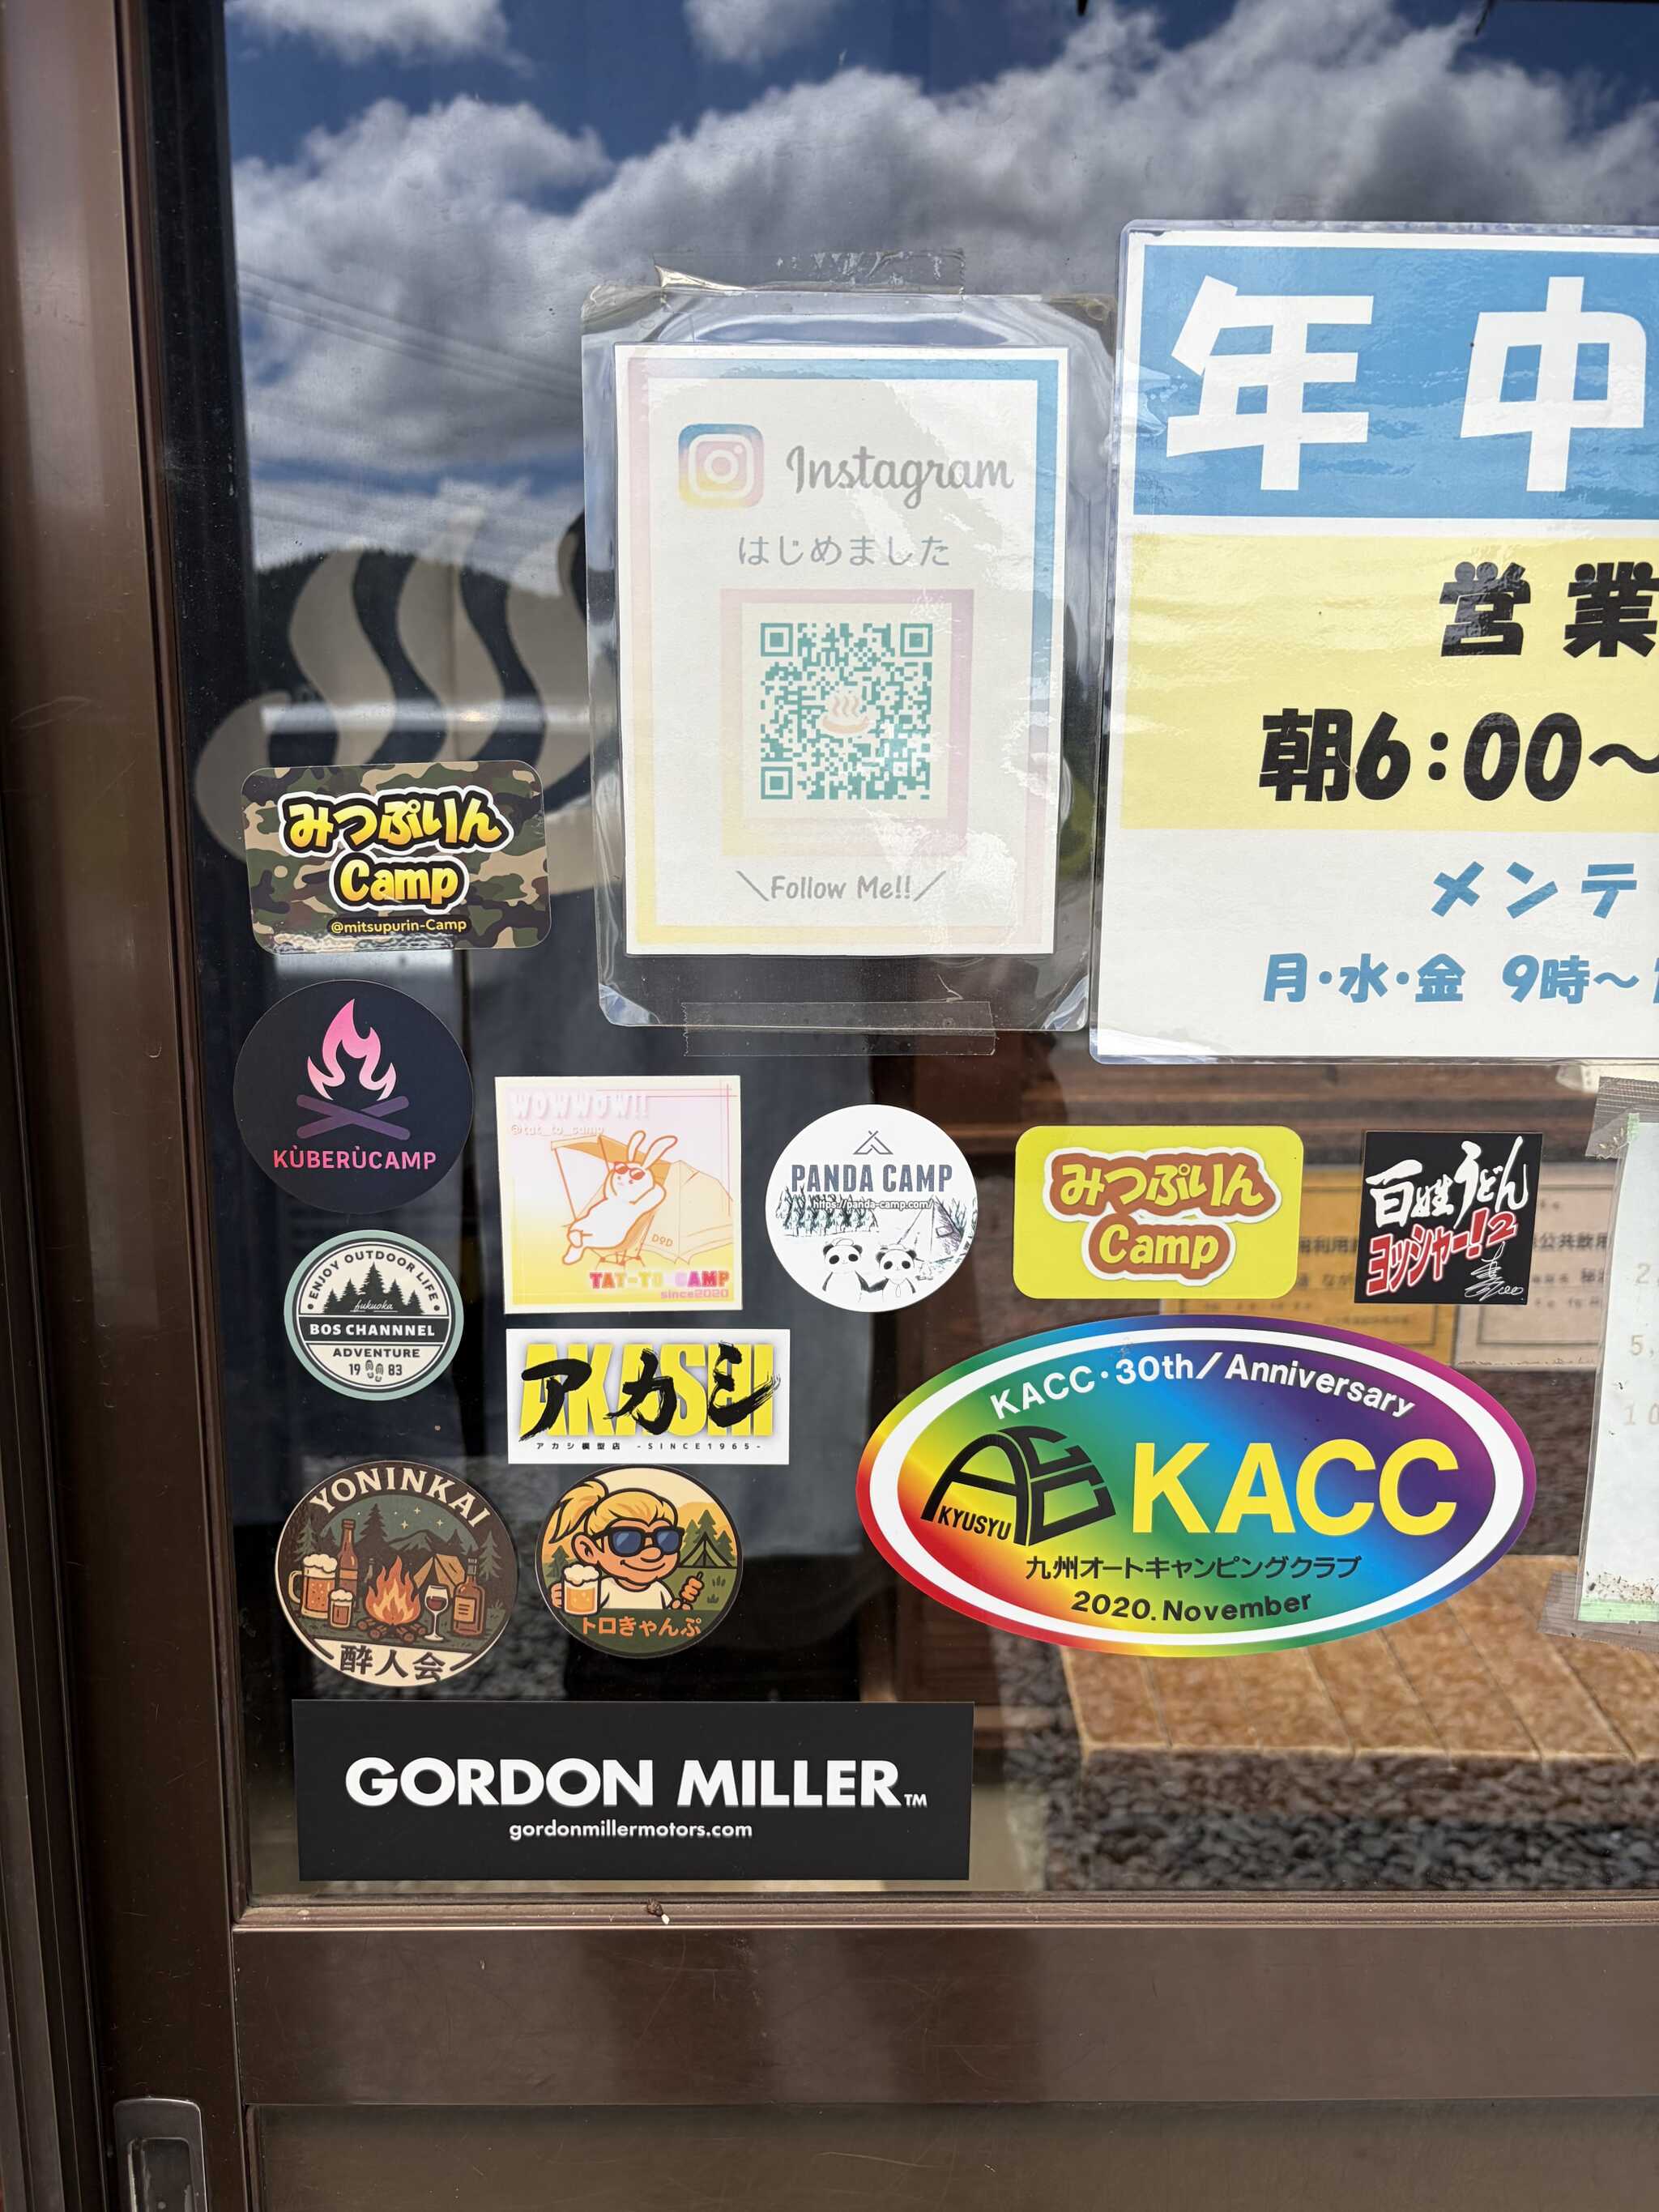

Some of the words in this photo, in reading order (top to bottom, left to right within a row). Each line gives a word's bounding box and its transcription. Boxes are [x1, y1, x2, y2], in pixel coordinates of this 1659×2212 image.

[1166, 274, 1648, 492] 年中
[786, 445, 1015, 510] Instagram
[738, 535, 951, 568] はじめました
[1438, 560, 1659, 658] 営業
[287, 796, 502, 848] みつぷりん
[339, 859, 458, 906] Camp
[769, 874, 845, 901] Follow
[855, 874, 912, 901] Me!!
[1431, 859, 1638, 920] メンテ
[331, 918, 467, 935] @mitsupurin-Camp
[1501, 952, 1659, 1005] 9時〜
[273, 1144, 437, 1170] KÙBERÙCAMP
[791, 1164, 875, 1192] PANDA
[882, 1164, 953, 1192] CAMP
[1059, 1162, 1265, 1208] みつぷりん
[812, 1198, 934, 1212] https://panda-camp.com/
[1098, 1223, 1219, 1270] Camp
[309, 1260, 340, 1300] ENJOY
[343, 1250, 416, 1273] OUTDOOR
[416, 1271, 439, 1302] LIFE
[353, 1299, 394, 1311] fukuoka
[309, 1323, 342, 1336] BOS
[345, 1323, 435, 1336] CHANNNEL
[332, 1348, 421, 1358] ADVENTURE
[348, 1363, 361, 1376] 19
[388, 1363, 403, 1376] 83
[518, 1340, 782, 1442] アカシ
[535, 1442, 621, 1451] アカシ模型店
[309, 1466, 492, 1528] YONINKAI
[1132, 1438, 1459, 1537] KACC
[937, 1505, 1013, 1541] KYUSYU
[1025, 1554, 1363, 1581] 九州オートキャンピングクラブ
[582, 1616, 702, 1639] トロきゃんぷ
[339, 1643, 446, 1681] 酔人会
[344, 1756, 654, 1808] GORDON
[676, 1759, 902, 1808] MILLER
[509, 1819, 753, 1841] gordonmillermotors.com
